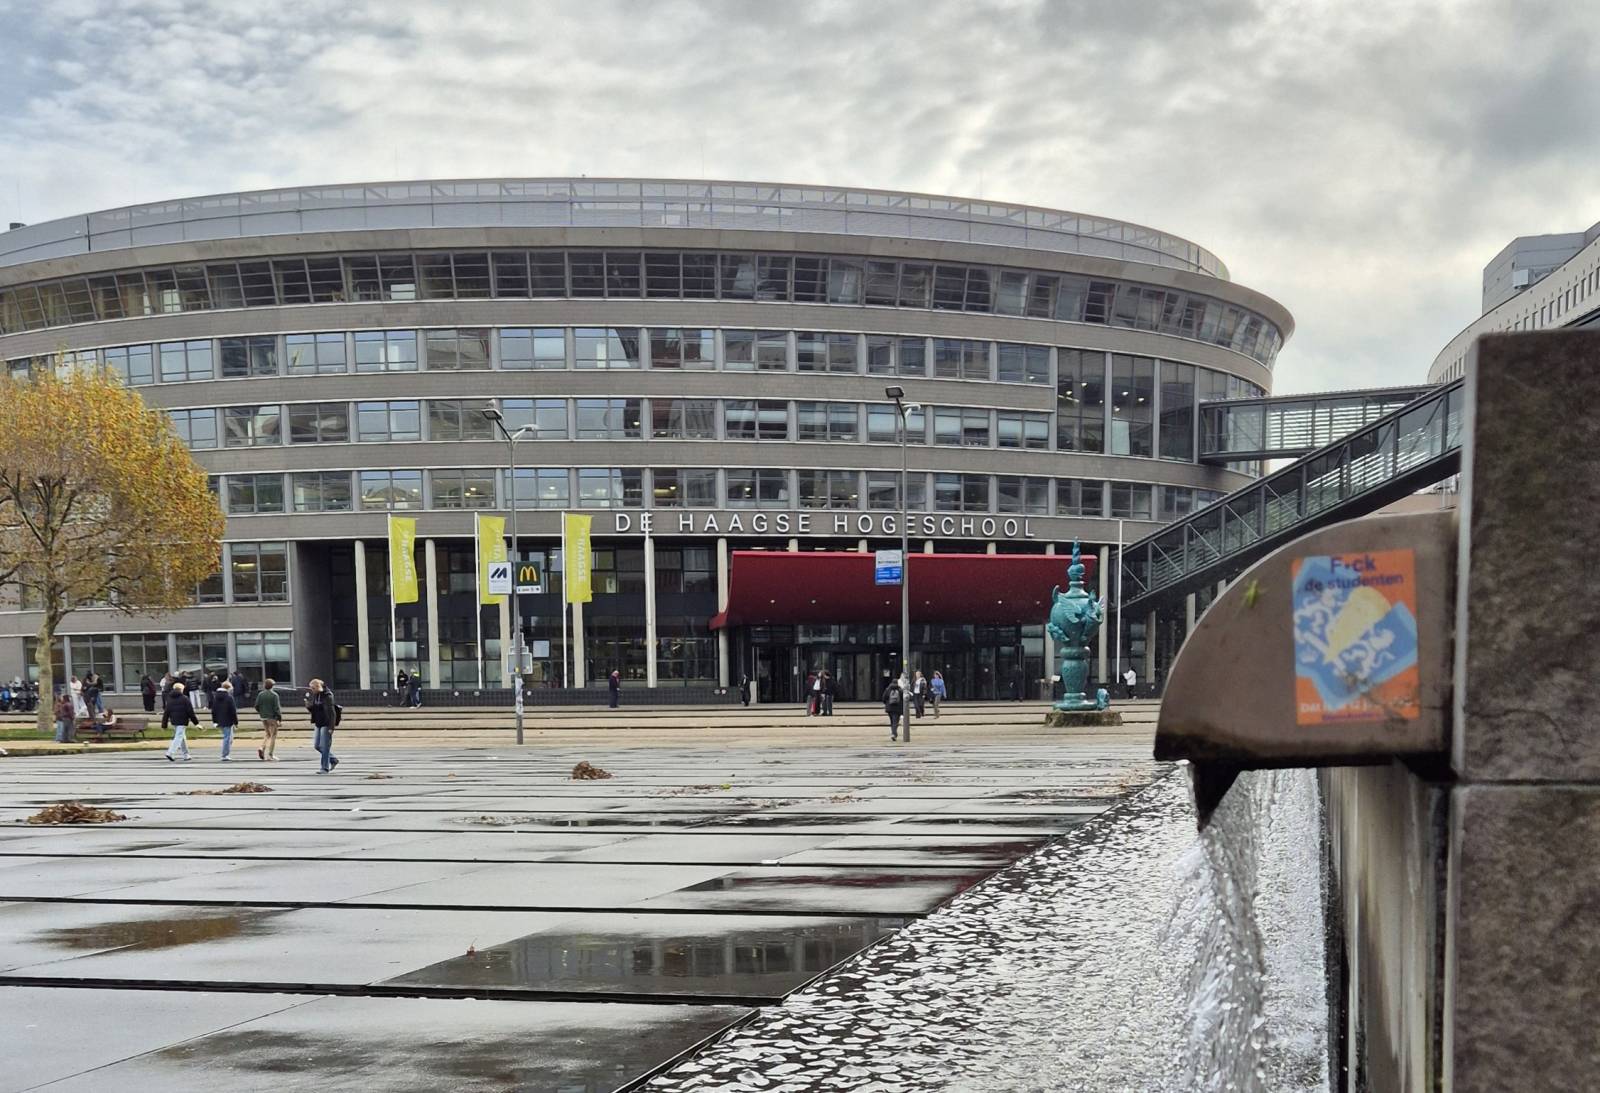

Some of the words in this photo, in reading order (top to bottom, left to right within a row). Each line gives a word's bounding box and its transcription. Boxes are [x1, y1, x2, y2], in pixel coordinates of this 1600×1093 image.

[615, 513, 653, 533] DE
[679, 513, 810, 534] HAAGSE
[834, 515, 1036, 537] HOGESCHOOL
[1304, 577, 1323, 591] de
[1328, 573, 1404, 590] studenten
